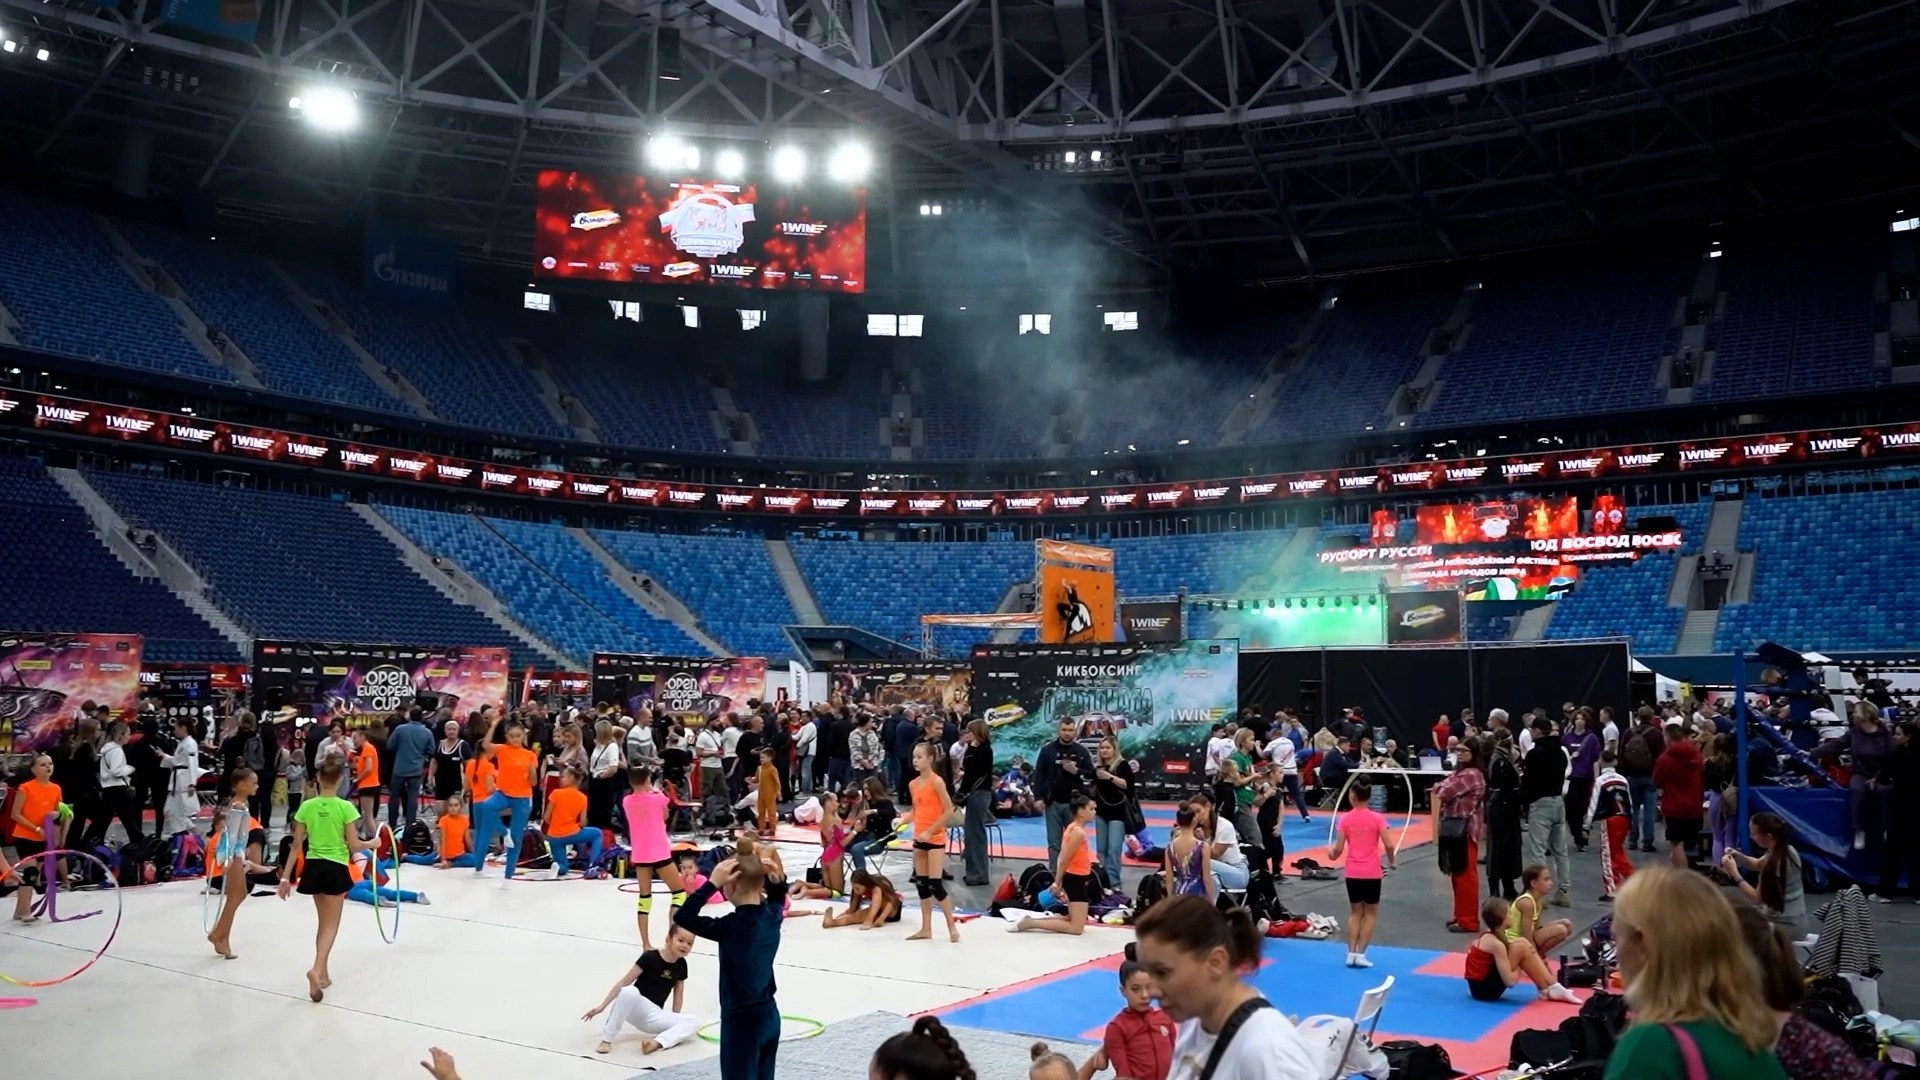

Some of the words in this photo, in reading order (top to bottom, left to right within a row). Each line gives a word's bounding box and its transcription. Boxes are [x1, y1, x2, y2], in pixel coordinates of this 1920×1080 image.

[782, 222, 822, 233] 1WIN
[710, 264, 750, 275] 1WIN
[1562, 535, 1631, 549] ВОСВОД
[1131, 618, 1166, 628] 1WIN
[1056, 665, 1143, 677] КИКБОКСИНГ
[372, 697, 401, 710] CUP
[672, 700, 691, 710] CUP
[1169, 708, 1219, 722] 1WIN
